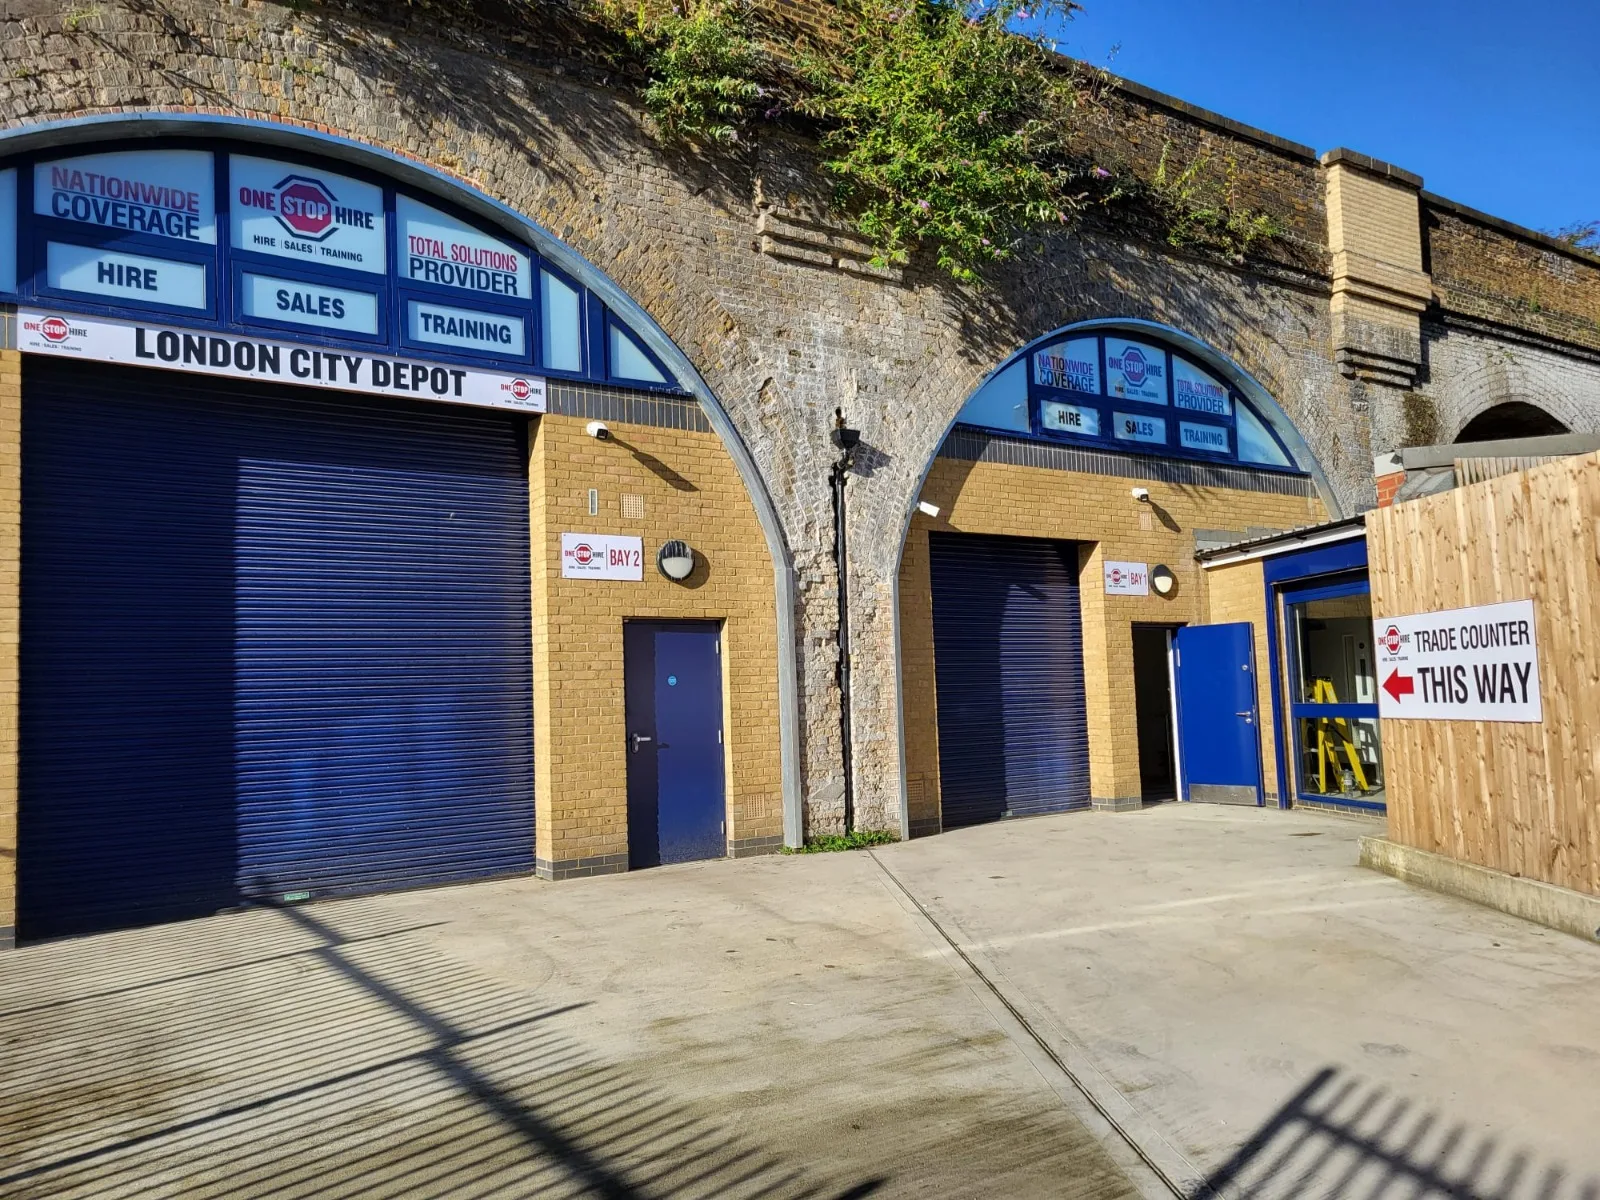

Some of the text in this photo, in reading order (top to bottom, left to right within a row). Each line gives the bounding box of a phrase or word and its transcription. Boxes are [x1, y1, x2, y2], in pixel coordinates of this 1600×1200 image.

[52, 166, 199, 213] NATIONWIDE
[52, 191, 200, 240] COVERAGE
[239, 187, 374, 230] ONE STOP HIRE
[254, 235, 363, 262] HIRE SALES TRAINING
[409, 235, 517, 272] TOTAL SOLUTIONS
[98, 261, 158, 291] HIRE
[409, 257, 518, 296] PROVIDER
[276, 289, 345, 319] SALES
[24, 322, 88, 337] ONE STOP HIRE
[420, 312, 512, 344] TRAINING
[135, 327, 466, 397] LONDON CITY DEPOT
[1038, 355, 1093, 376] NATIONWIDE
[1108, 356, 1162, 377] ONE STOP HIRE
[501, 383, 512, 391] ONE
[514, 386, 528, 394] STOP
[1040, 369, 1094, 393] COVERAGE
[1177, 379, 1223, 398] TOTAL SOLUTIONS
[1178, 394, 1225, 414] PROVIDER
[1058, 410, 1082, 426] HIRE
[1125, 419, 1153, 436] SALES
[1183, 428, 1223, 446] TRAINING
[610, 549, 640, 567] BAY 2
[1131, 573, 1142, 585] BAY
[1143, 573, 1147, 585] 1
[1414, 620, 1530, 652] TRADE COUNTER
[1417, 662, 1532, 704] THIS WAY
